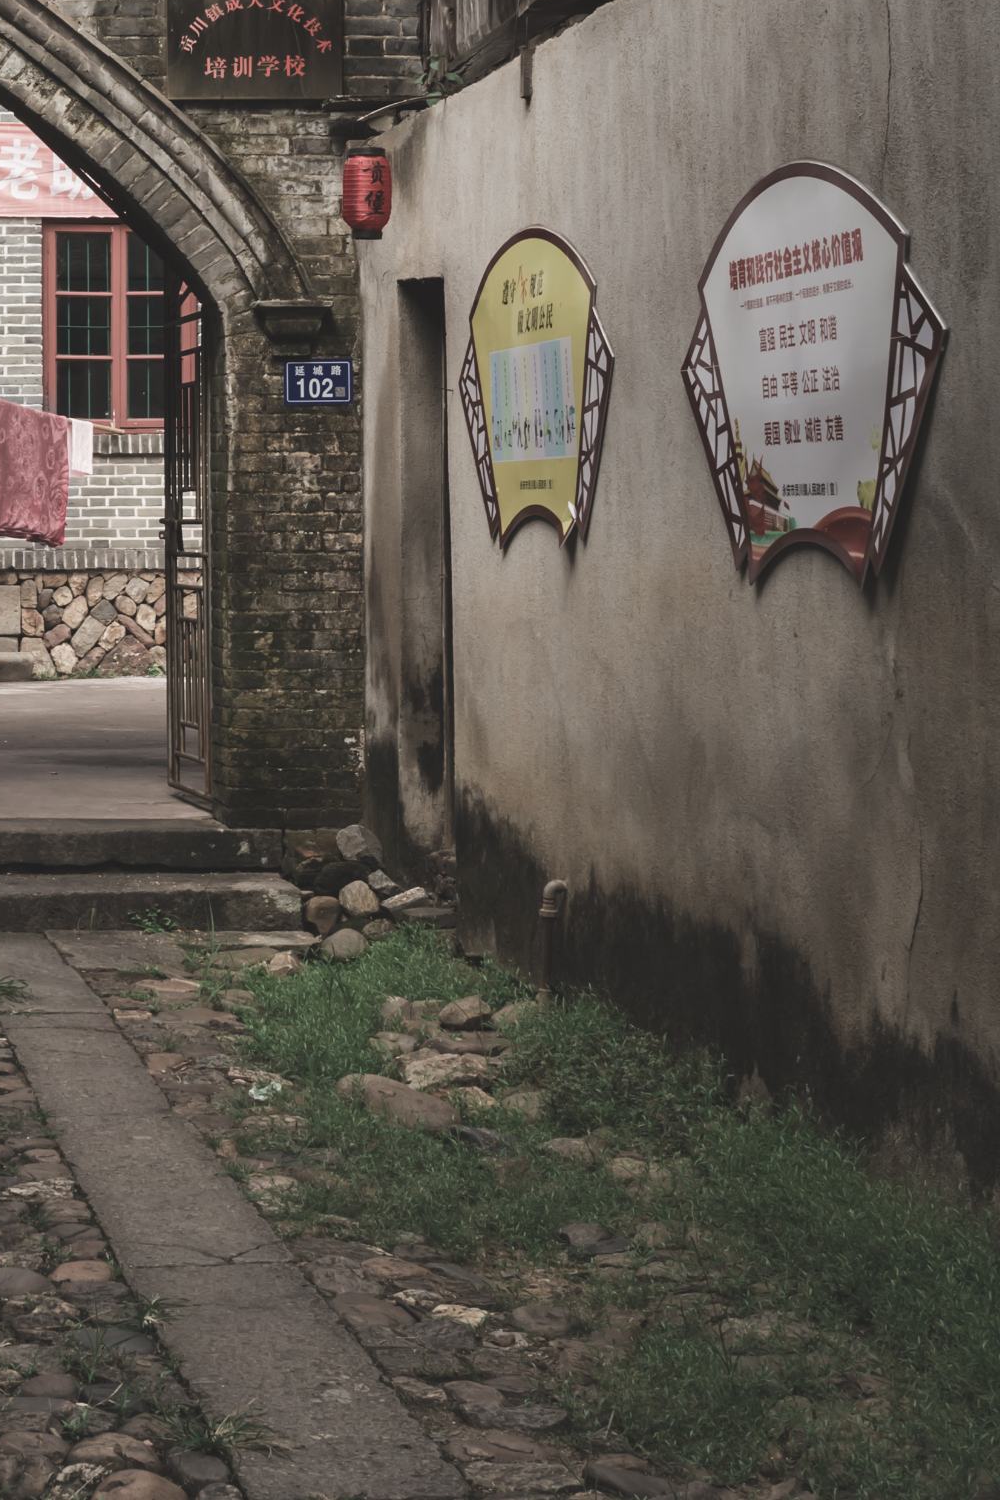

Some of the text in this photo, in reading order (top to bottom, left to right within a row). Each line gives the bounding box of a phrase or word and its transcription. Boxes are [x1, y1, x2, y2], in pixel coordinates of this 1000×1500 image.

[204, 54, 306, 79] 培训学校
[729, 227, 864, 291] 培育和践行社会主义核心价值观
[759, 315, 837, 352] 富强 民主 文明 和谐
[294, 365, 342, 376] 延城路
[762, 365, 840, 399] 自由 平等 公正 法治
[296, 378, 334, 399] 102
[764, 415, 844, 446] 爱国 敬业 诚信 友善
